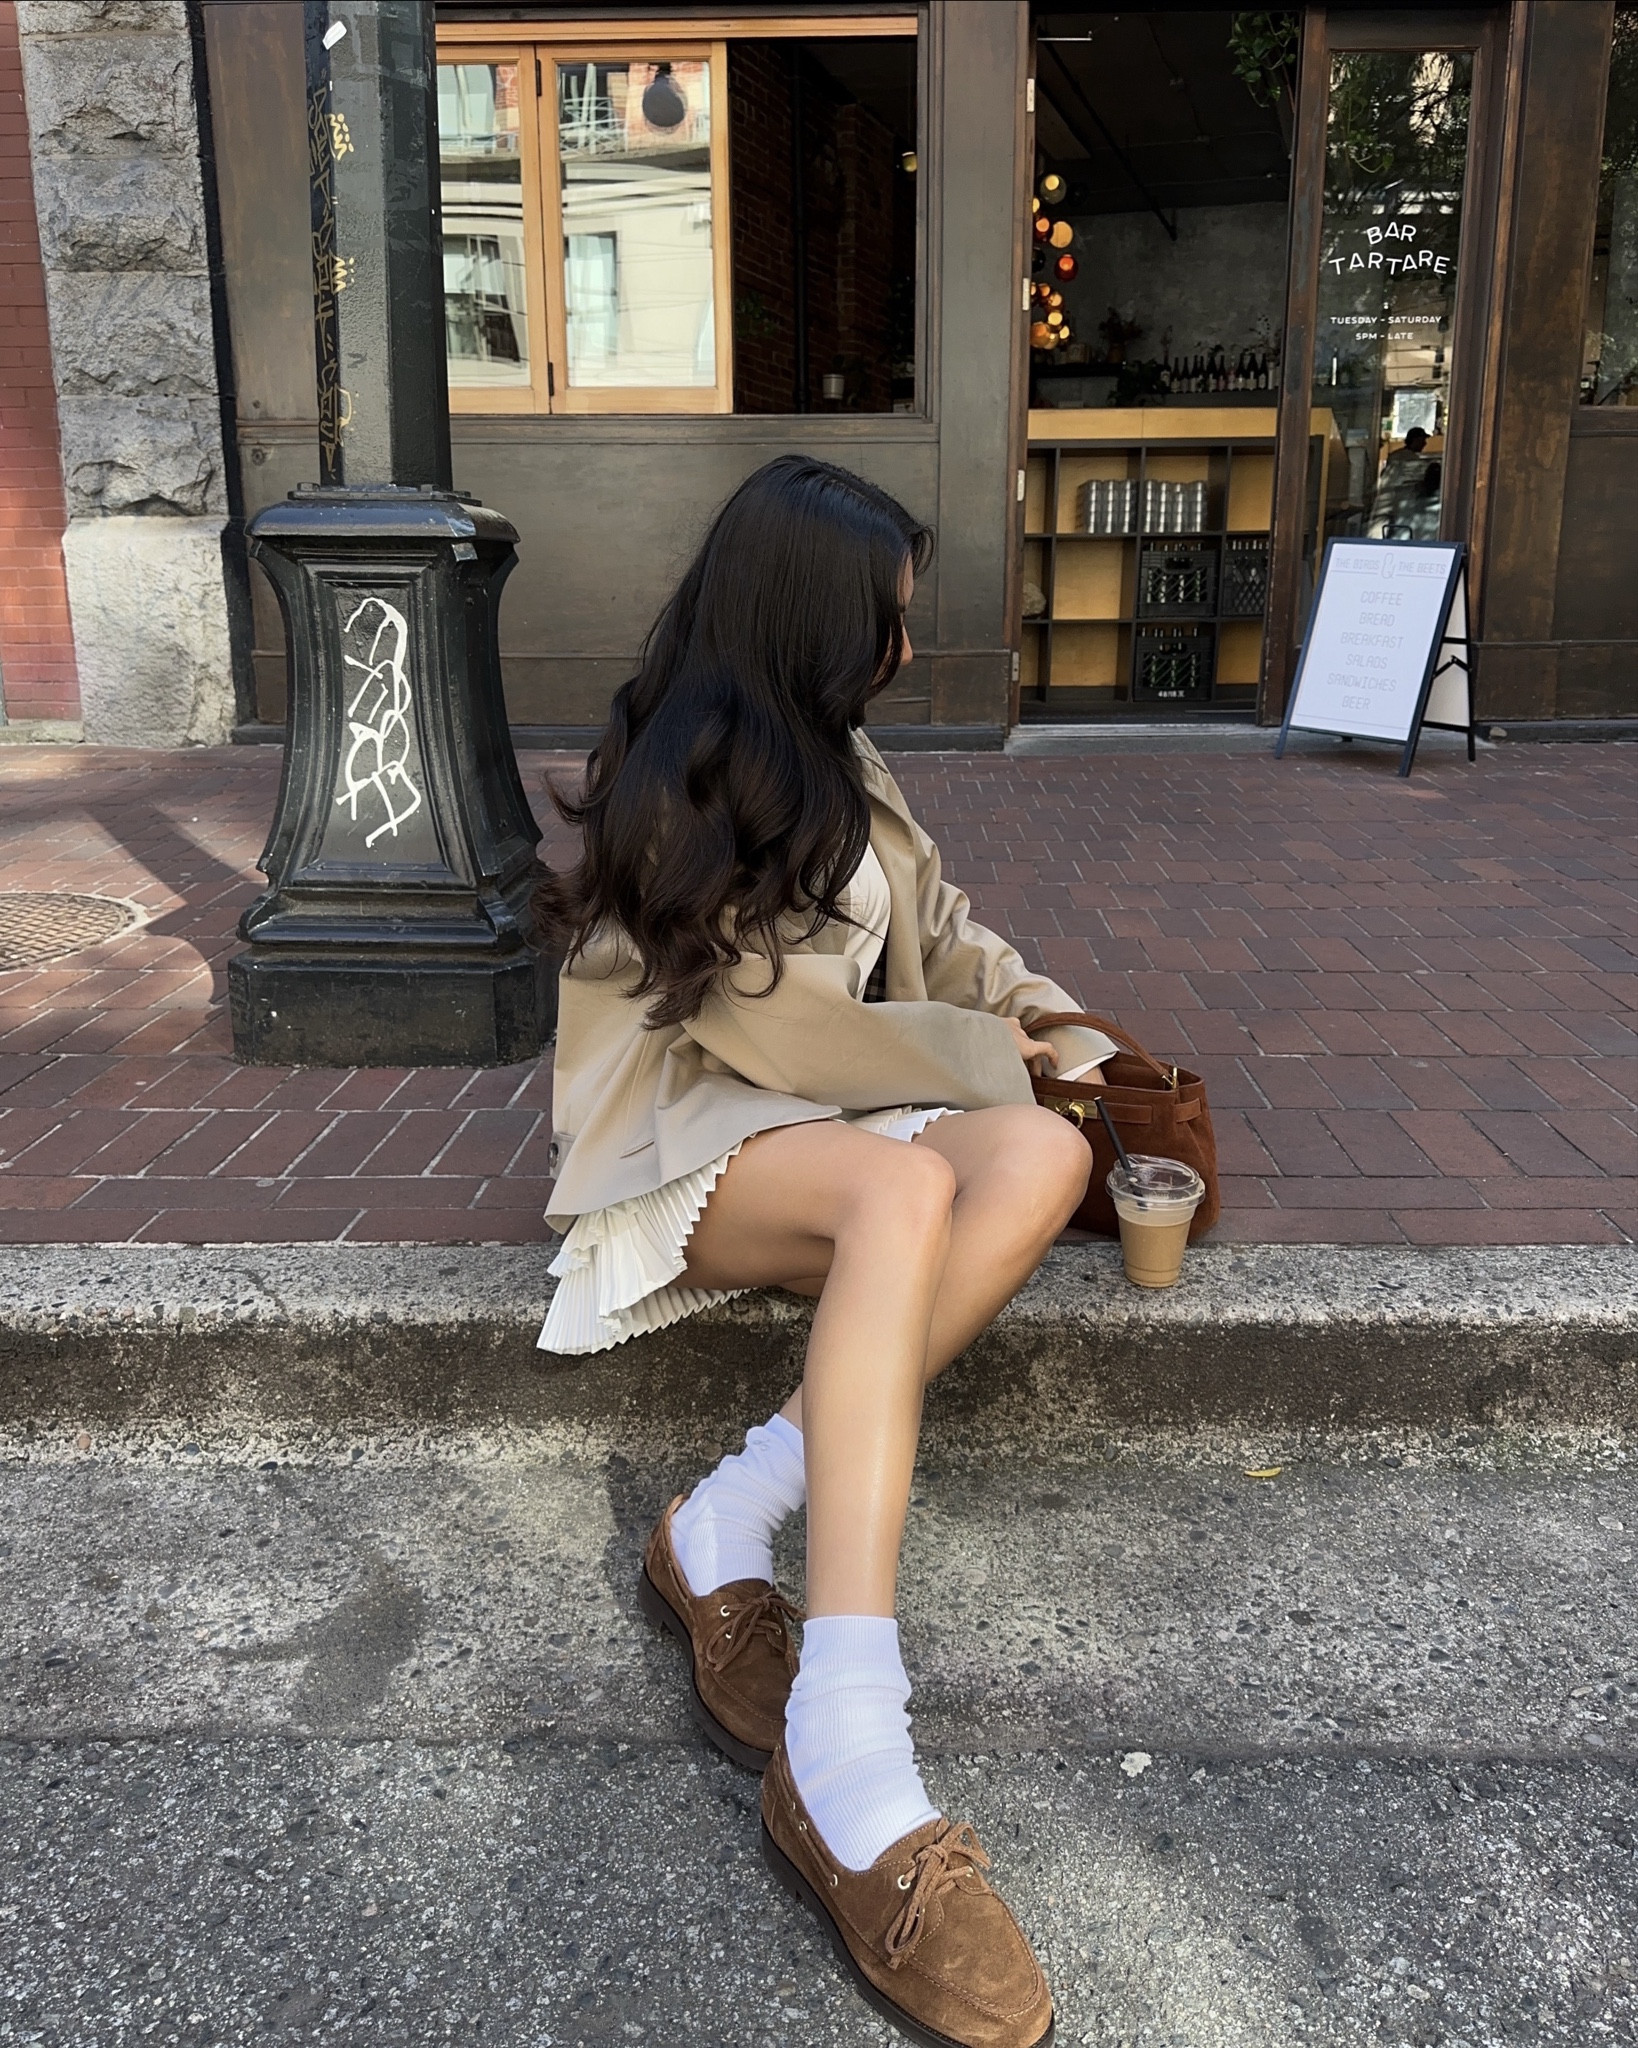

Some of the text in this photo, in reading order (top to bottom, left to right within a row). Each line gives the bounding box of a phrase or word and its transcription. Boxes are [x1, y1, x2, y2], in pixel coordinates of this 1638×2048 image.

[1366, 221, 1417, 245] BAR
[1328, 250, 1451, 275] TARTARE
[1330, 316, 1378, 325] TUESDAY
[1387, 316, 1442, 324] SATURDAY
[1355, 332, 1378, 341] 5PM
[1387, 332, 1414, 340] LATE
[1335, 557, 1351, 569] THE
[1353, 558, 1380, 570] BIRDS
[1398, 560, 1415, 573] THE
[1417, 562, 1447, 575] BEETS
[1360, 590, 1404, 606] COFFEE
[1359, 611, 1396, 627] BREAD
[1340, 631, 1404, 649] BREAKFAST
[1345, 653, 1389, 669] SALADS
[1326, 672, 1398, 692] SANDWICHES
[1341, 695, 1371, 710] BEER
